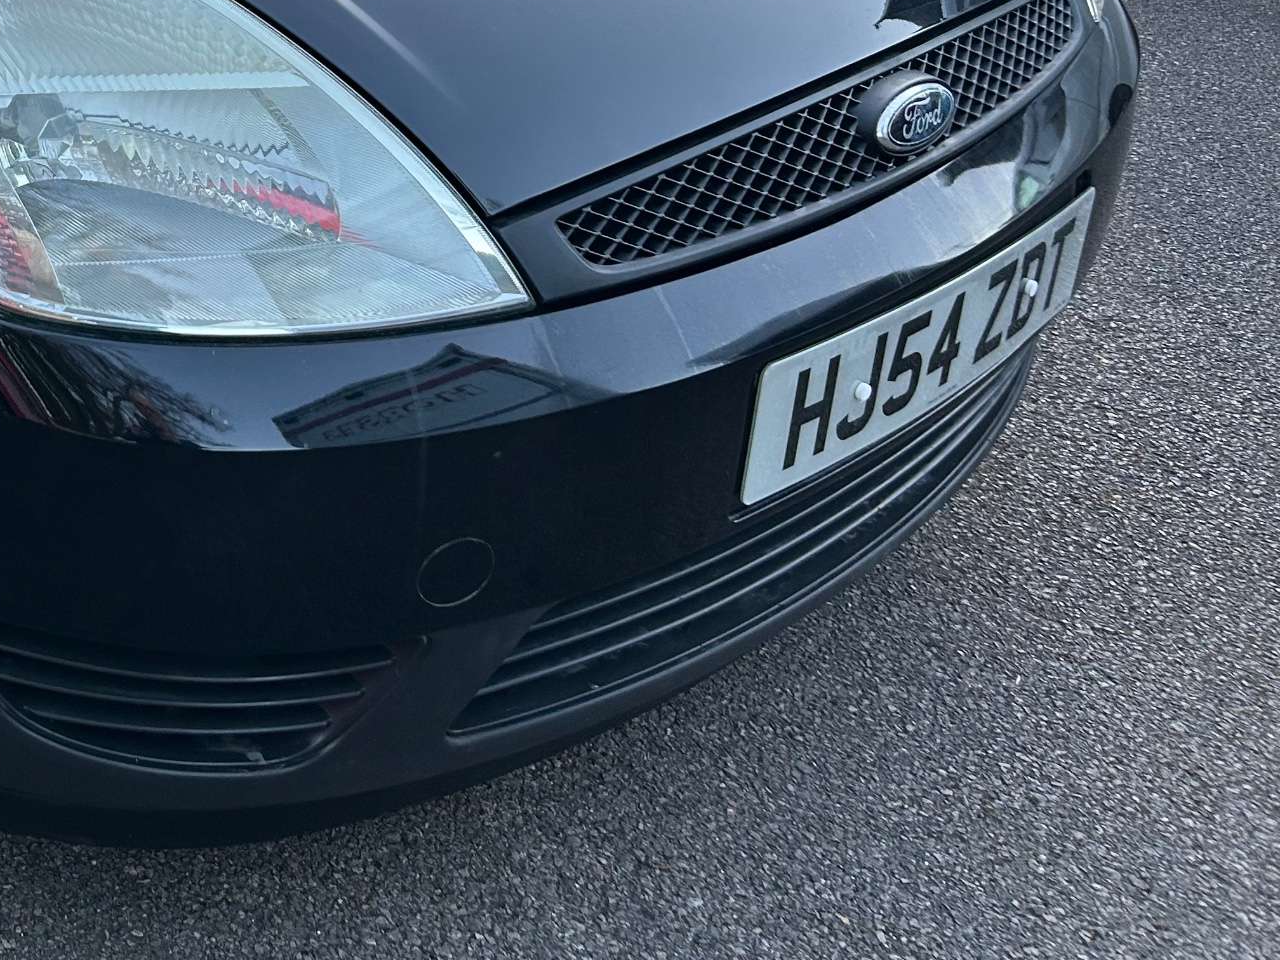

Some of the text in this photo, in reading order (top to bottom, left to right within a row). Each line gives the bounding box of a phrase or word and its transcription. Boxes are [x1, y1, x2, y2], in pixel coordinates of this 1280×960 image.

[903, 94, 943, 139] Ford
[782, 217, 1077, 471] HJ54 ZDT
